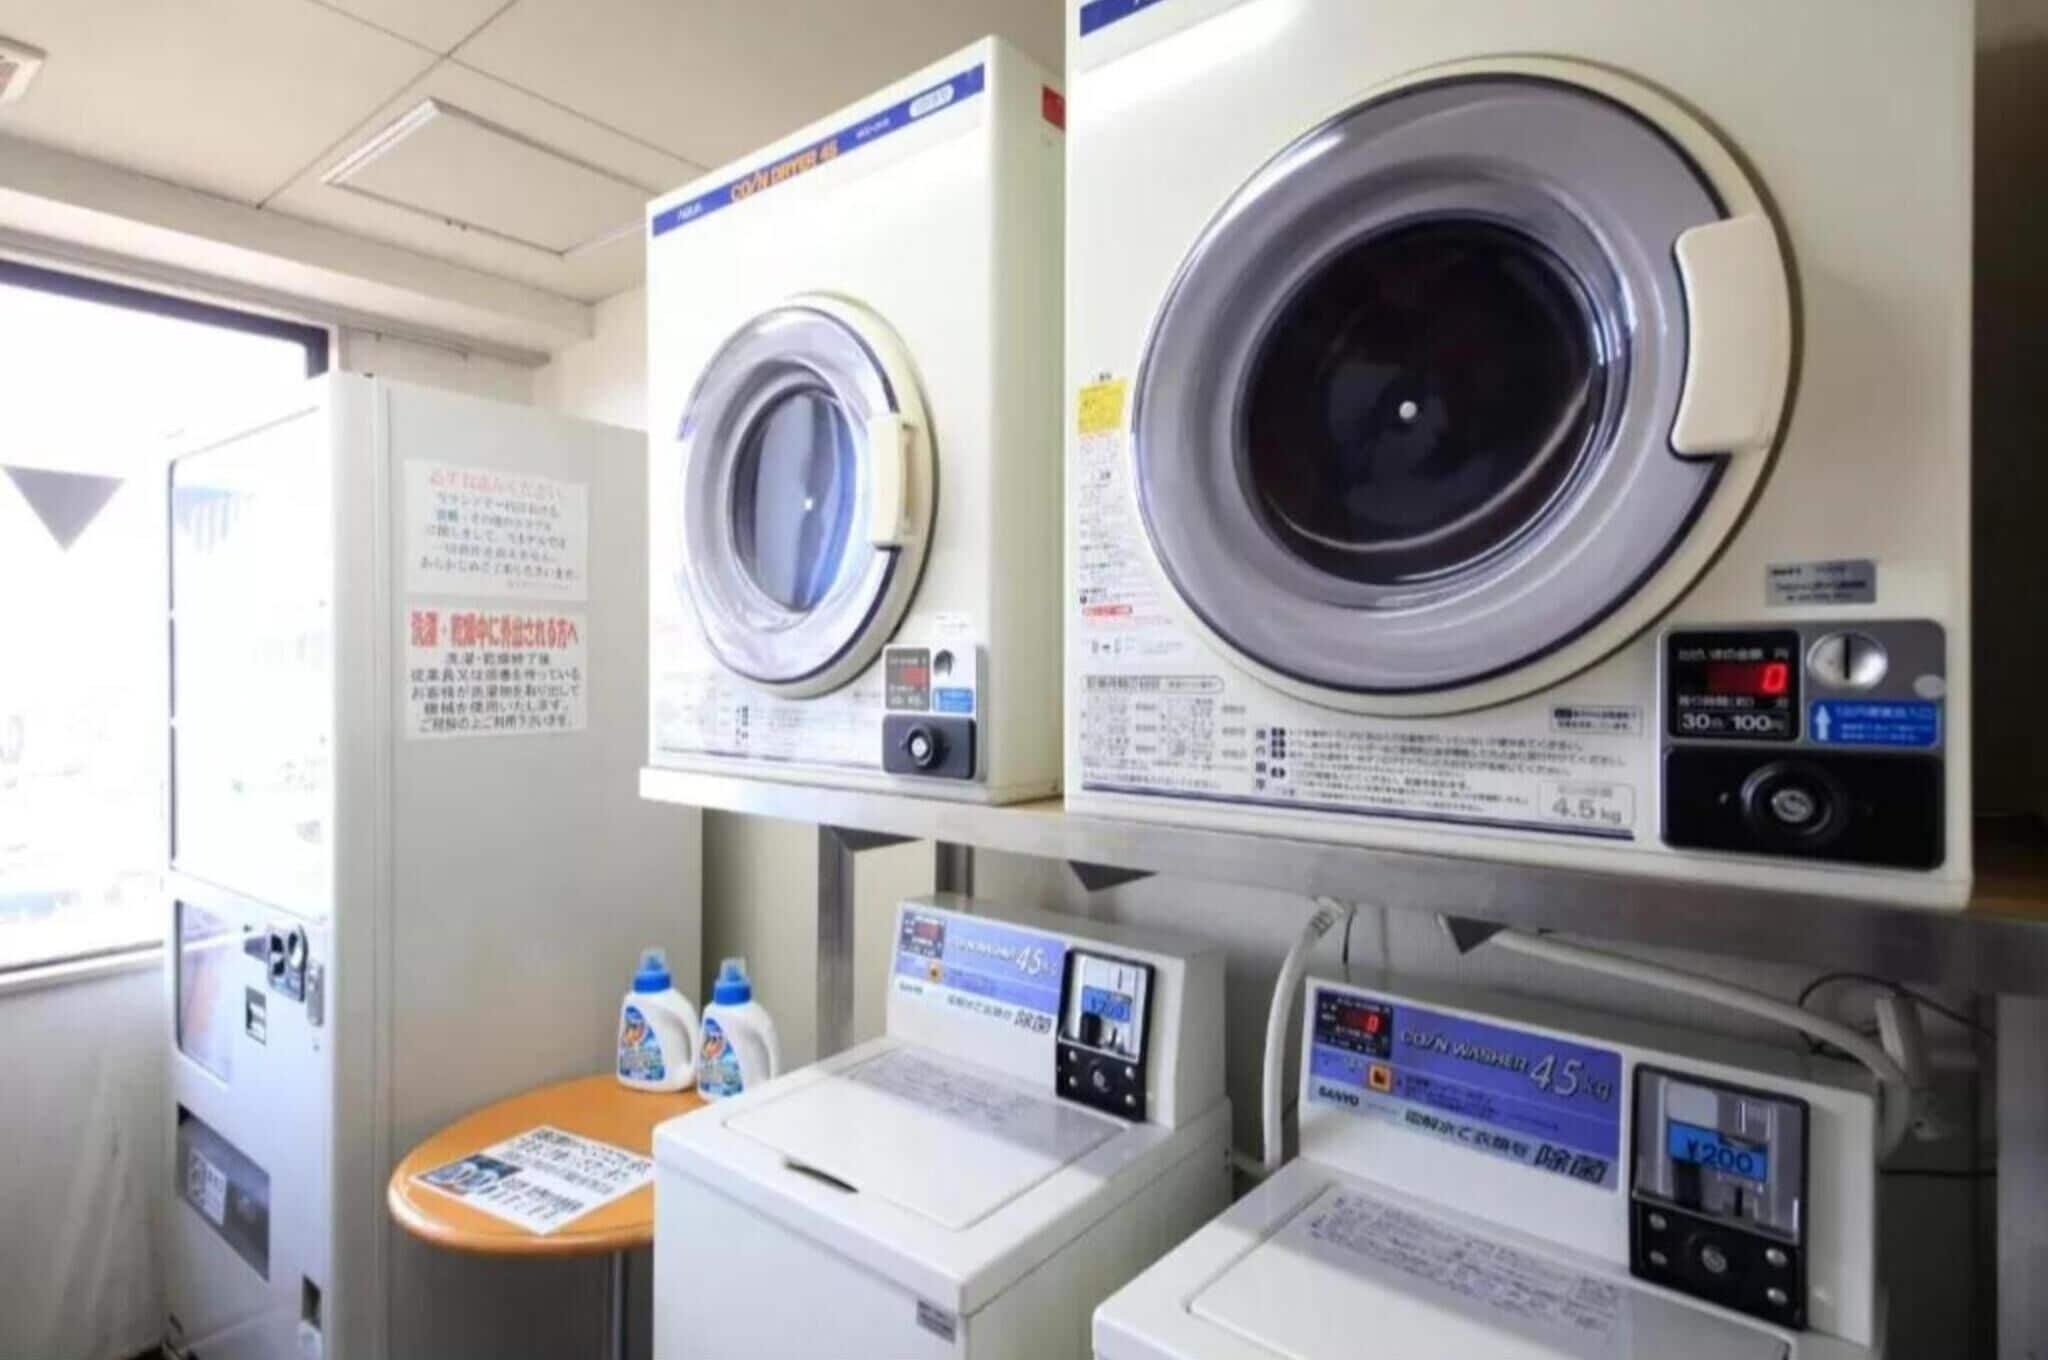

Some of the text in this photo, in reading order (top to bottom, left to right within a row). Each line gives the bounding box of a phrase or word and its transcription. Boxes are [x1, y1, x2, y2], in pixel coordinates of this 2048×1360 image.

[1759, 662, 1788, 694] 0
[1552, 797, 1623, 825] 4.5 kg
[1452, 1039, 1529, 1073] WASHER
[1318, 1085, 1360, 1107] SANYO
[1532, 1143, 1609, 1185] 除菌
[1685, 1138, 1754, 1174] ¥200
